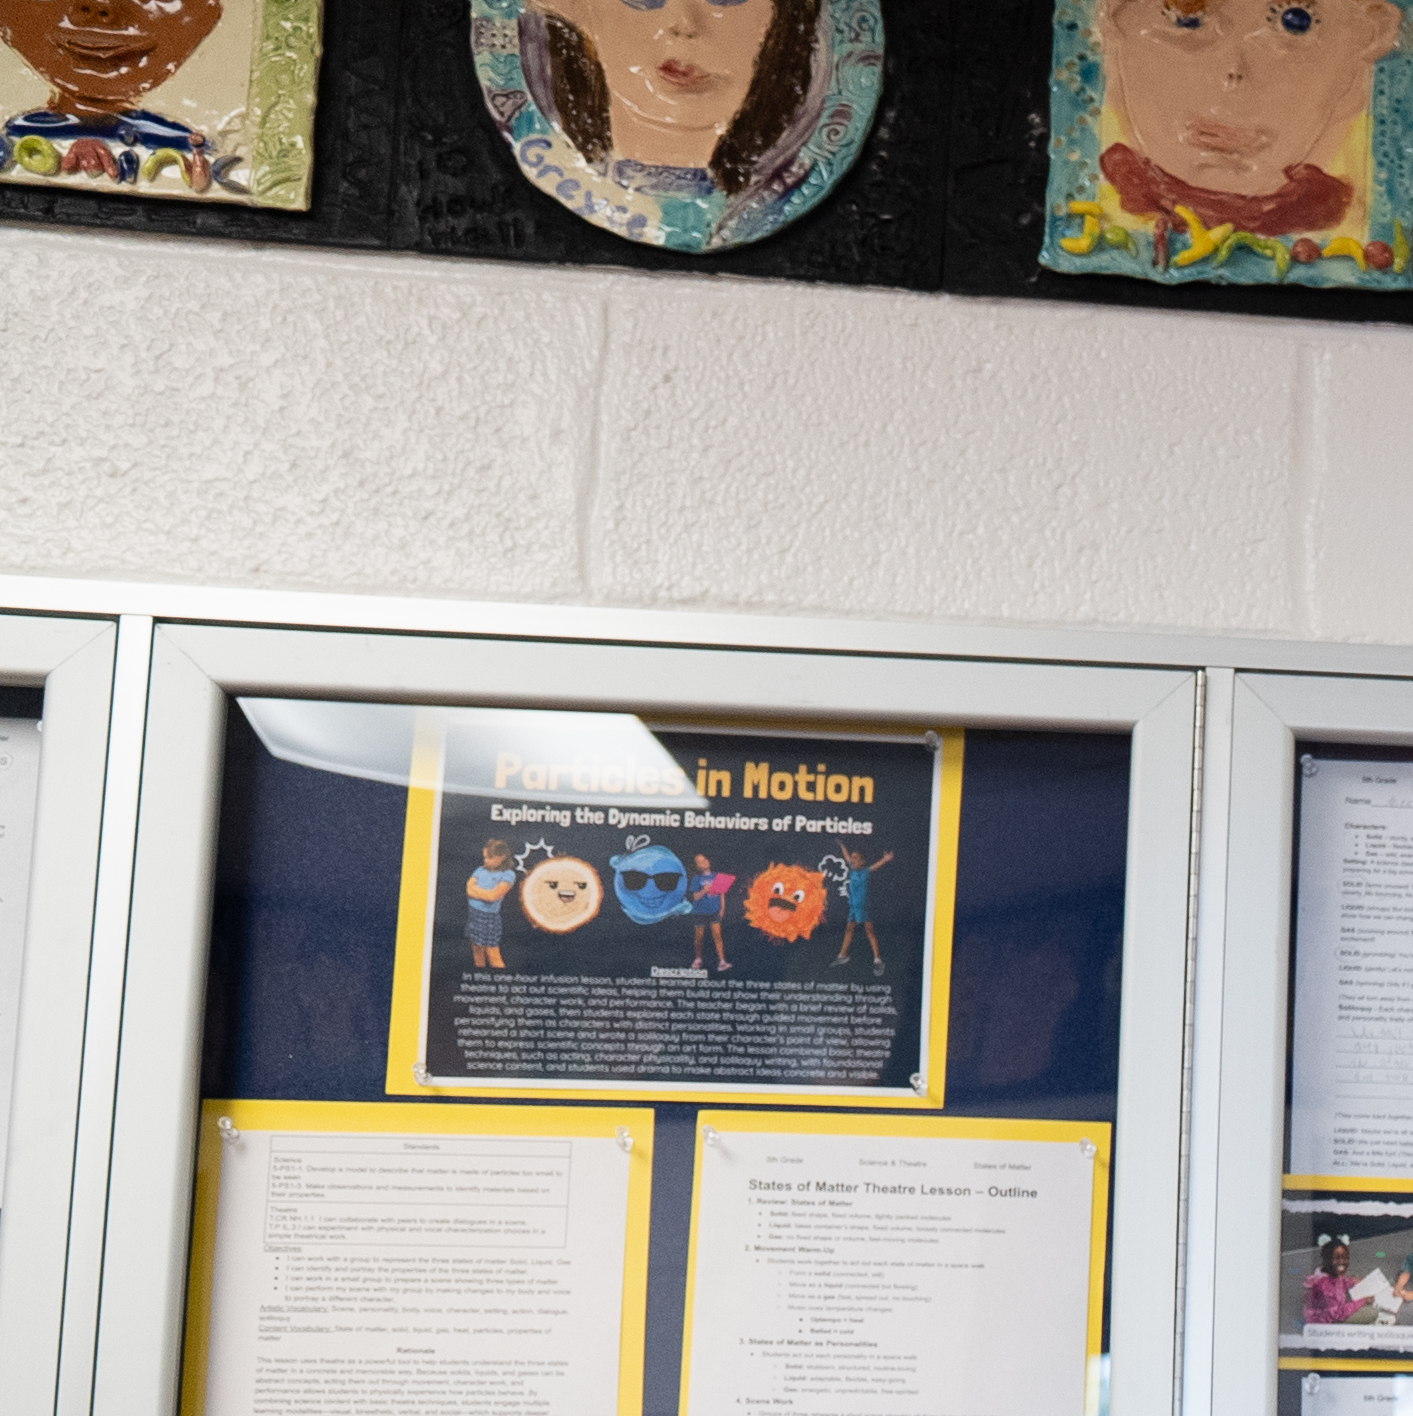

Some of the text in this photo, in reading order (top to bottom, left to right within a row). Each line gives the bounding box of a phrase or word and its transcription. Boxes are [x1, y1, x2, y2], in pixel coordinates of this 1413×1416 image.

[494, 751, 874, 804] Particles in Motion
[490, 803, 872, 834] Exploring the Dynamic Behaviors of Particles
[650, 965, 708, 979] Description
[748, 1179, 792, 1191] States
[796, 1180, 811, 1192] of
[814, 1181, 858, 1193] Matter
[864, 1181, 916, 1195] Theatre
[920, 1186, 971, 1196] Lesson
[987, 1185, 1037, 1198] Outline
